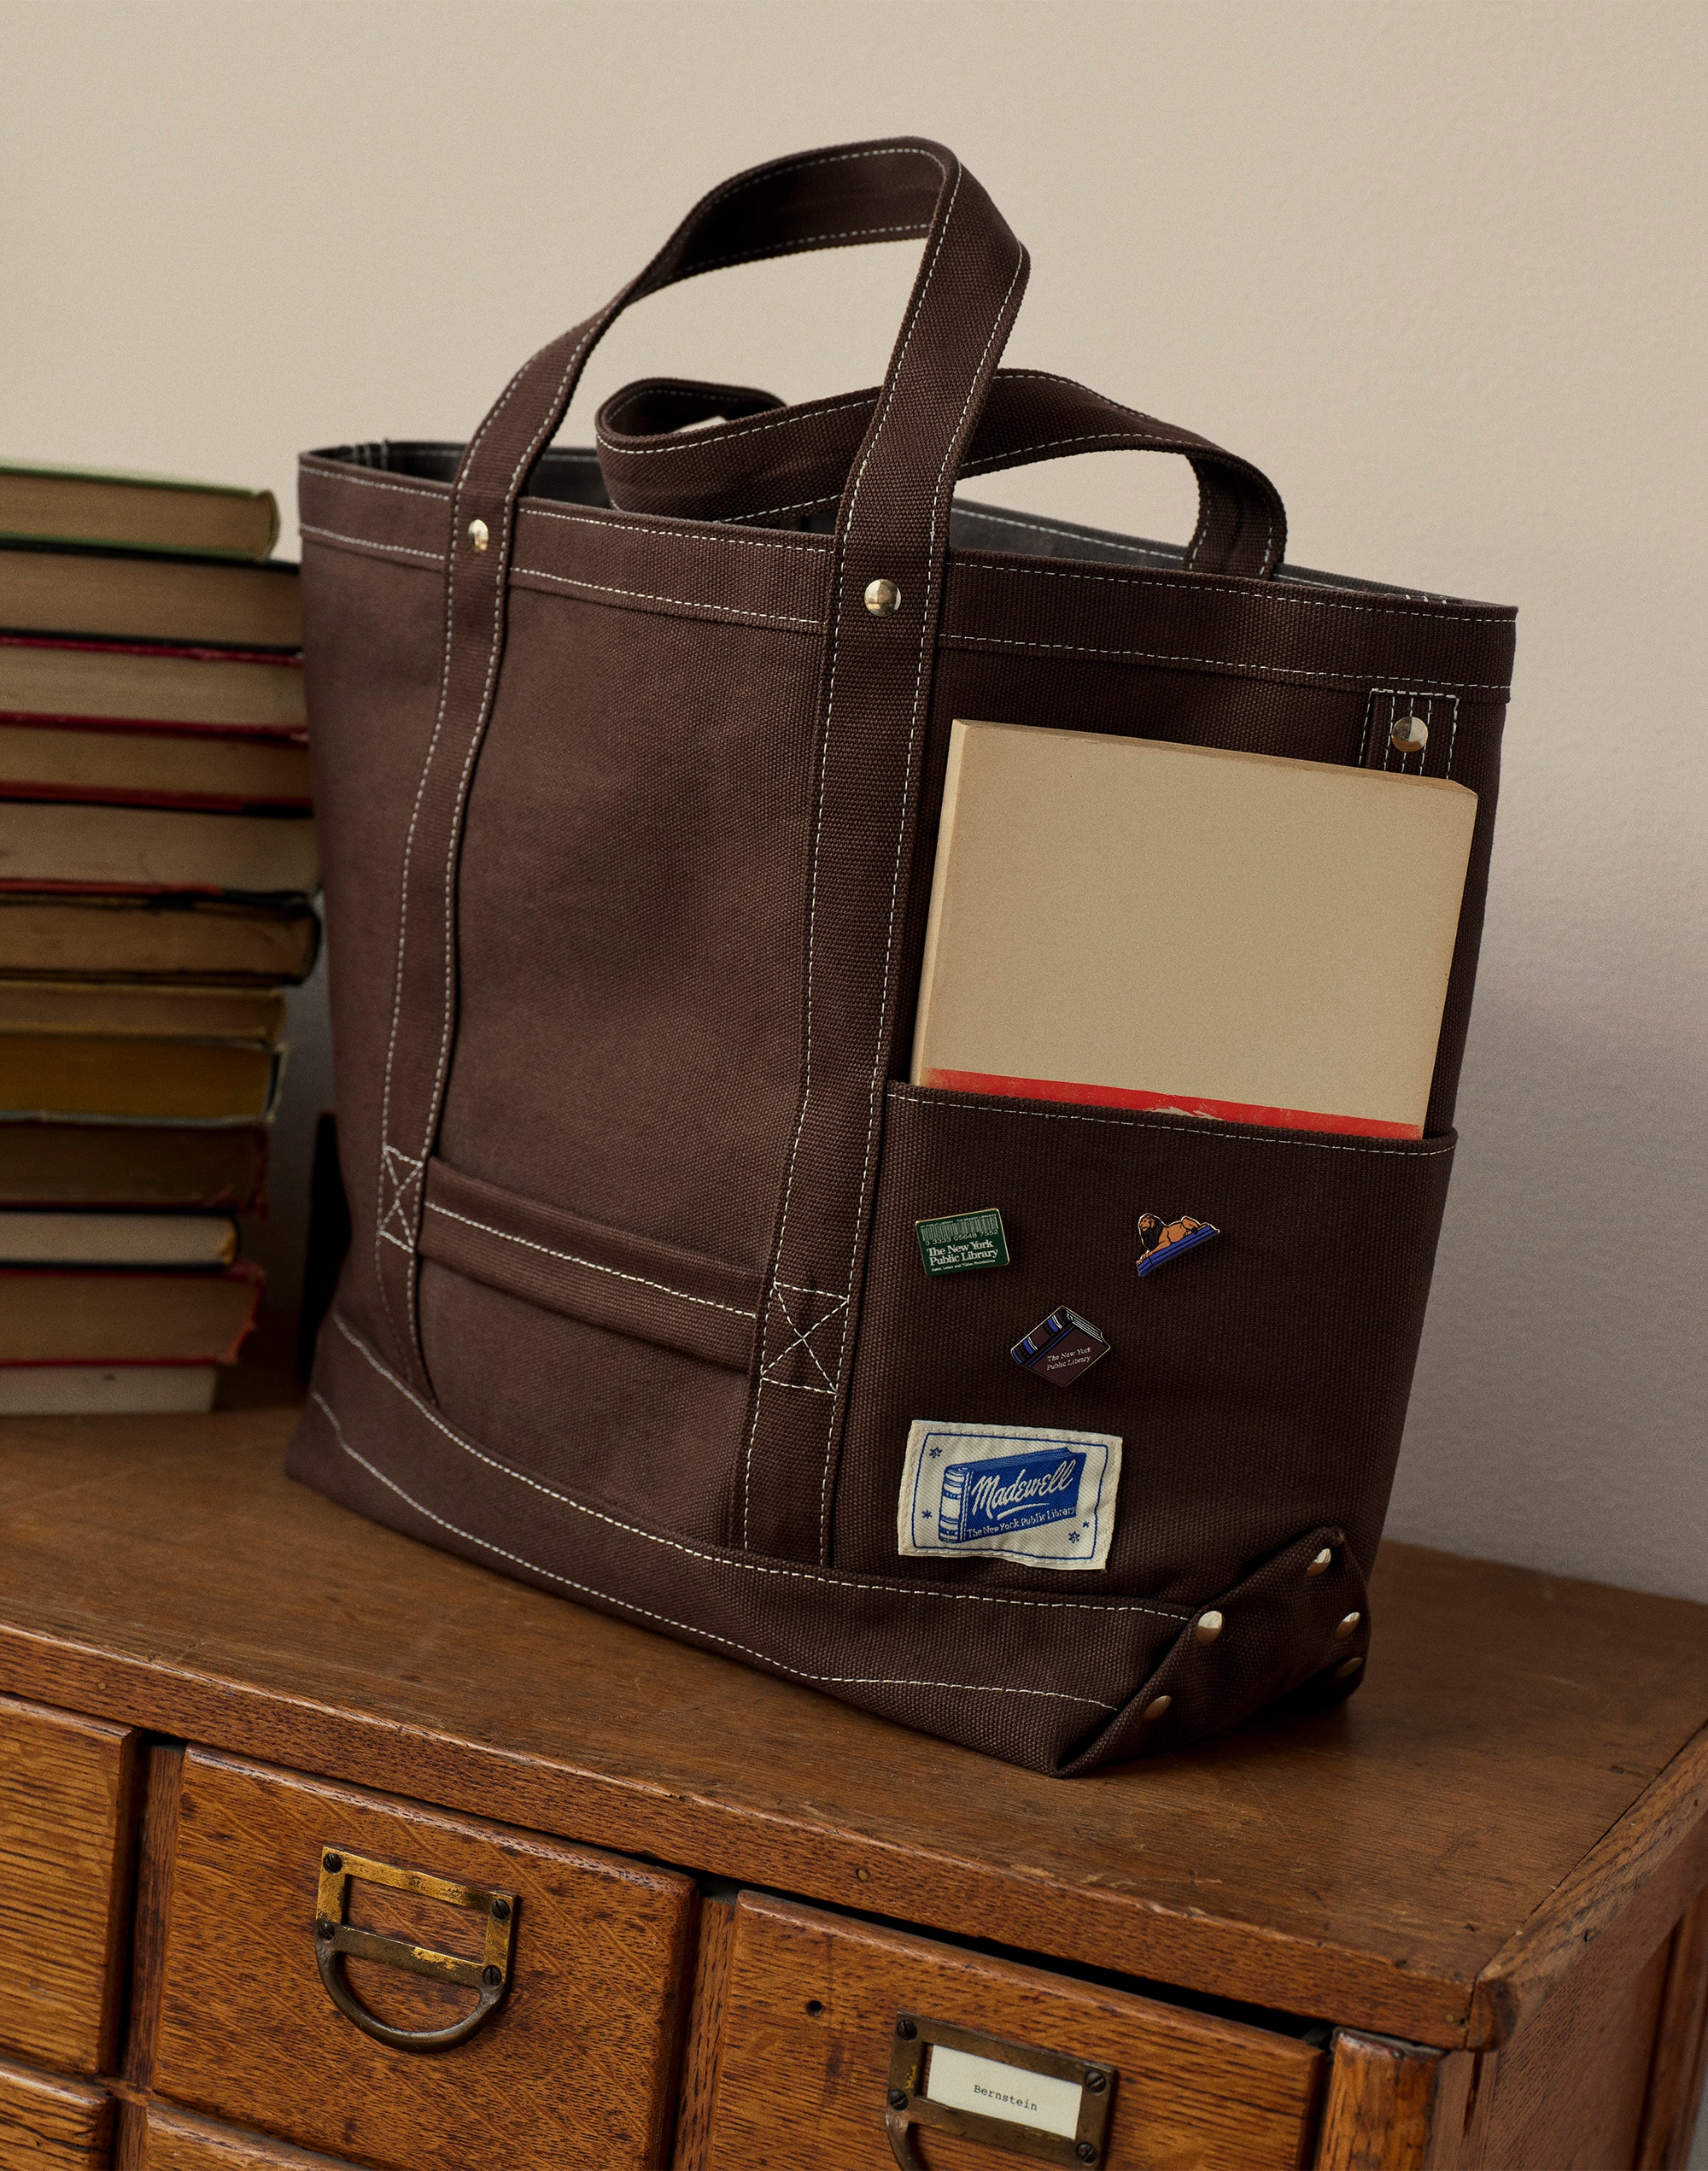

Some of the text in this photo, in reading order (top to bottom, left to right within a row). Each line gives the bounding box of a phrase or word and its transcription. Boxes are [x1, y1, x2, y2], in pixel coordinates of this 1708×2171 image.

[926, 1239, 994, 1257] The New York
[929, 1254, 960, 1267] Public
[961, 1249, 999, 1261] Library
[1060, 1351, 1076, 1360] New
[1076, 1346, 1092, 1355] York
[1046, 1355, 1091, 1371] Public Library
[970, 1459, 1077, 1519] Madewell
[966, 1506, 1077, 1538] The New York Public Library
[973, 2084, 1038, 2112] Bernstein
